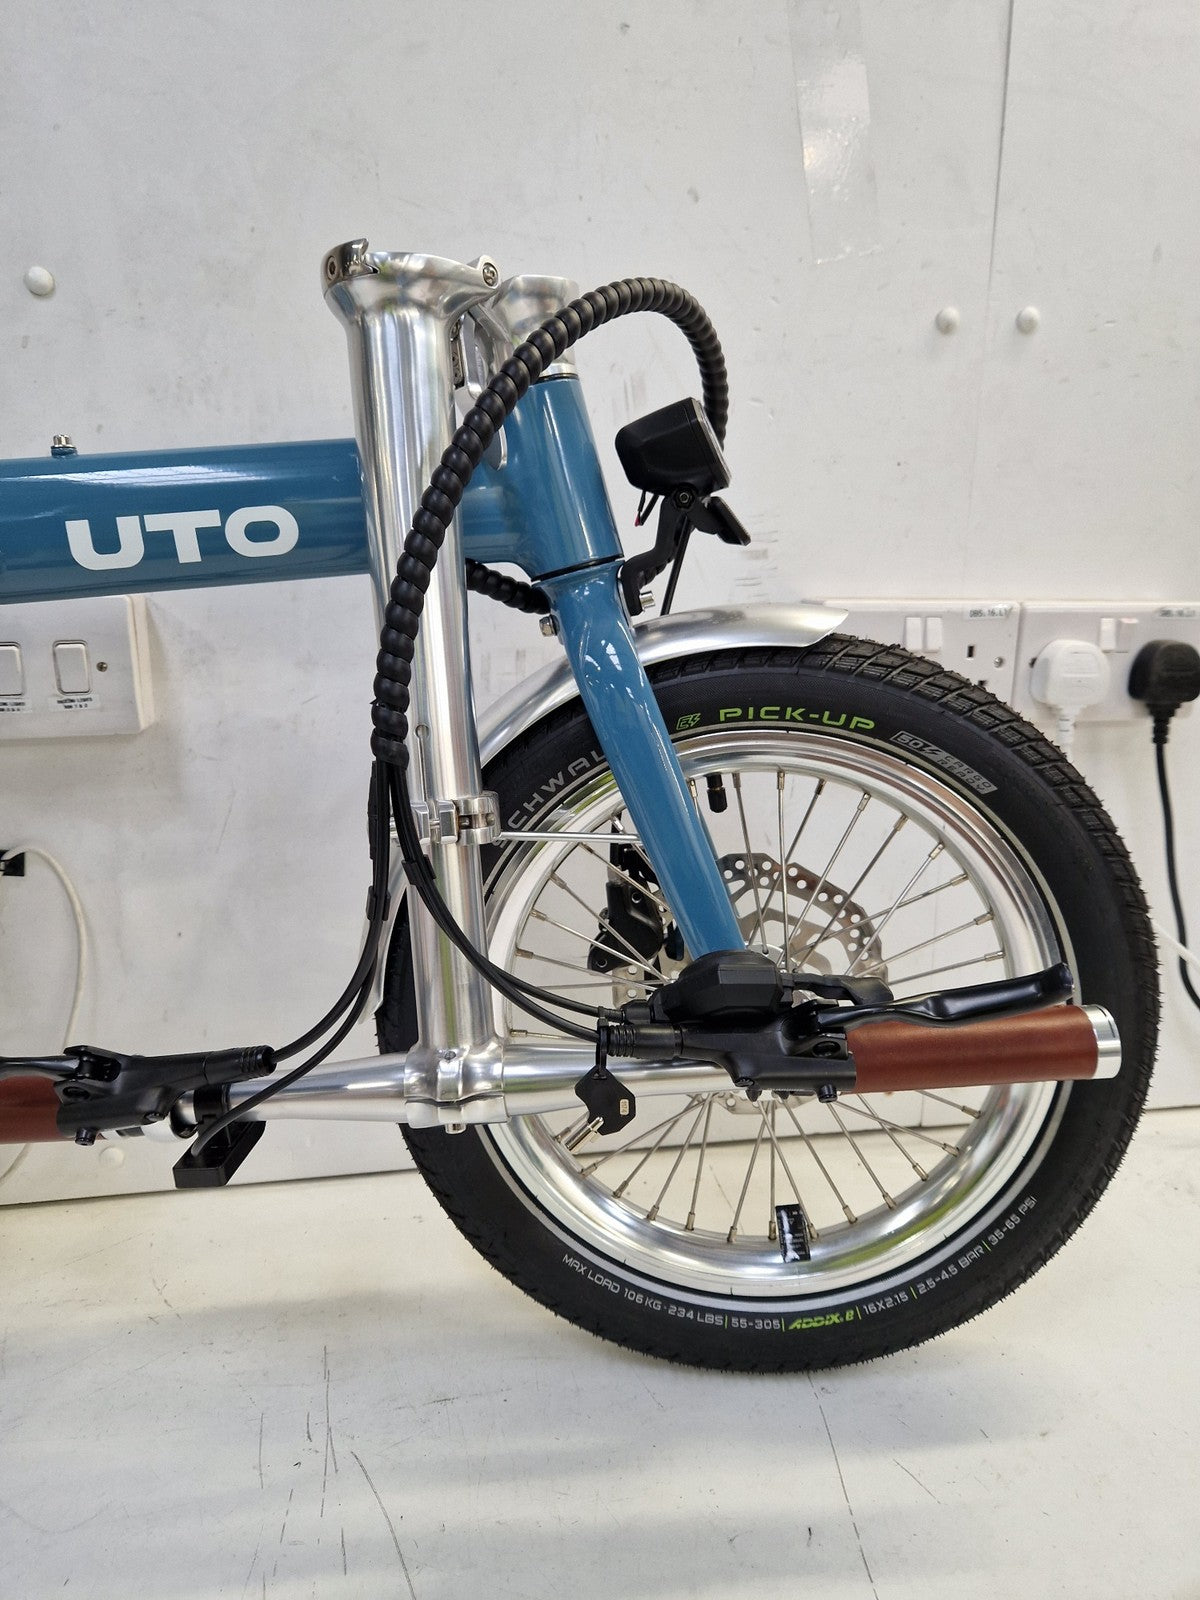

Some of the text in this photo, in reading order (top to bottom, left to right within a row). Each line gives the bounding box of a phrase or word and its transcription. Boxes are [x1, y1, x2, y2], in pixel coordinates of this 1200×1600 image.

[65, 505, 299, 571] UTO
[719, 706, 875, 730] PICK-UP
[945, 755, 991, 788] CARGO
[562, 1253, 588, 1275] MAX
[587, 1269, 620, 1294] LOAD
[623, 1288, 644, 1304] 106
[644, 1297, 662, 1311] KG
[668, 1305, 694, 1319] 234
[697, 1312, 724, 1326] LBS
[731, 1317, 781, 1330] 55-305
[958, 1245, 985, 1269] BAR
[987, 1213, 1021, 1246] 35-65
[1018, 1195, 1037, 1215] PSI
